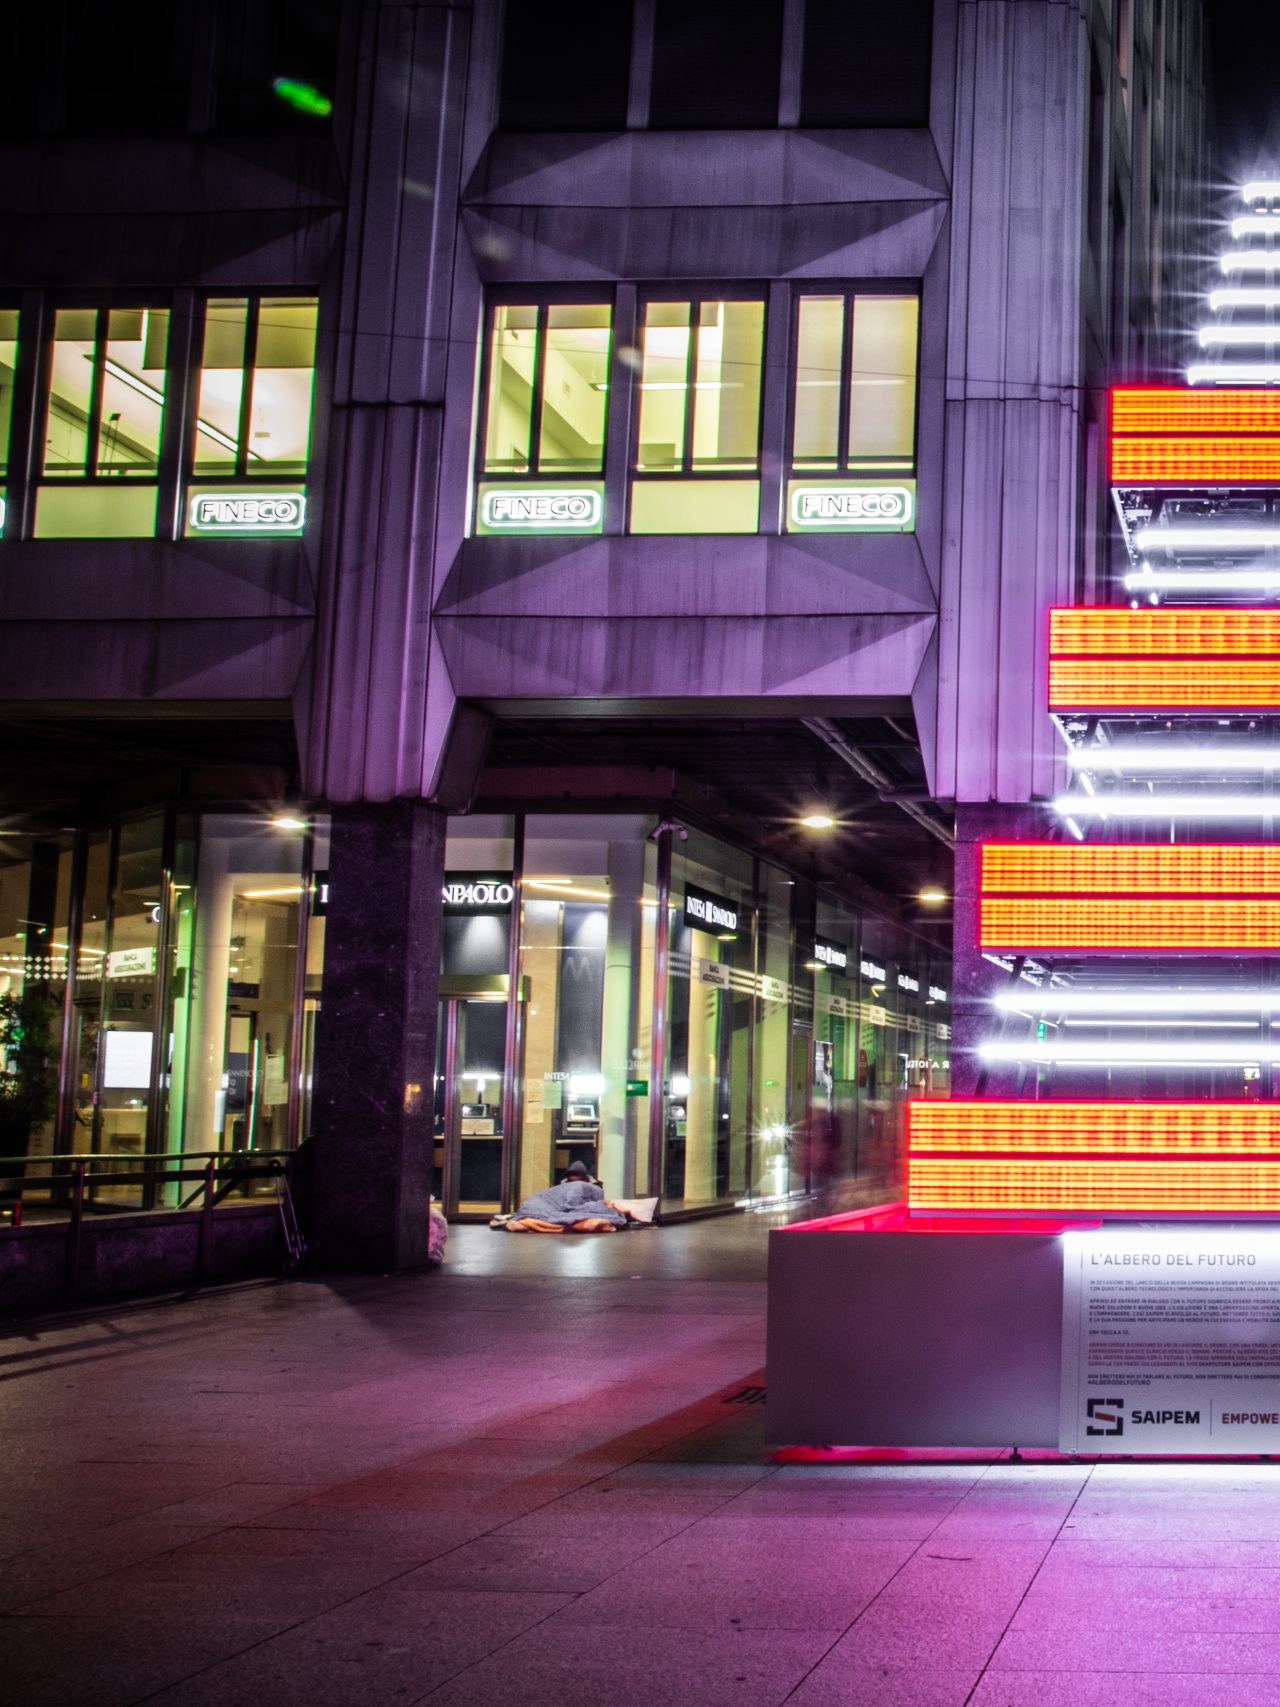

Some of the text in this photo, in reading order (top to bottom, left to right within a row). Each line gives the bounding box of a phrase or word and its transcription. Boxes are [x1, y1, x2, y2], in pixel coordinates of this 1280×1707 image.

[202, 500, 297, 522] FINECO
[493, 497, 590, 519] FINECO
[803, 495, 901, 517] FINECO
[442, 884, 515, 904] NPAOLO
[1091, 1254, 1257, 1266] L'ALBERO DEL FUTURO
[1131, 1411, 1200, 1424] SAIPEM
